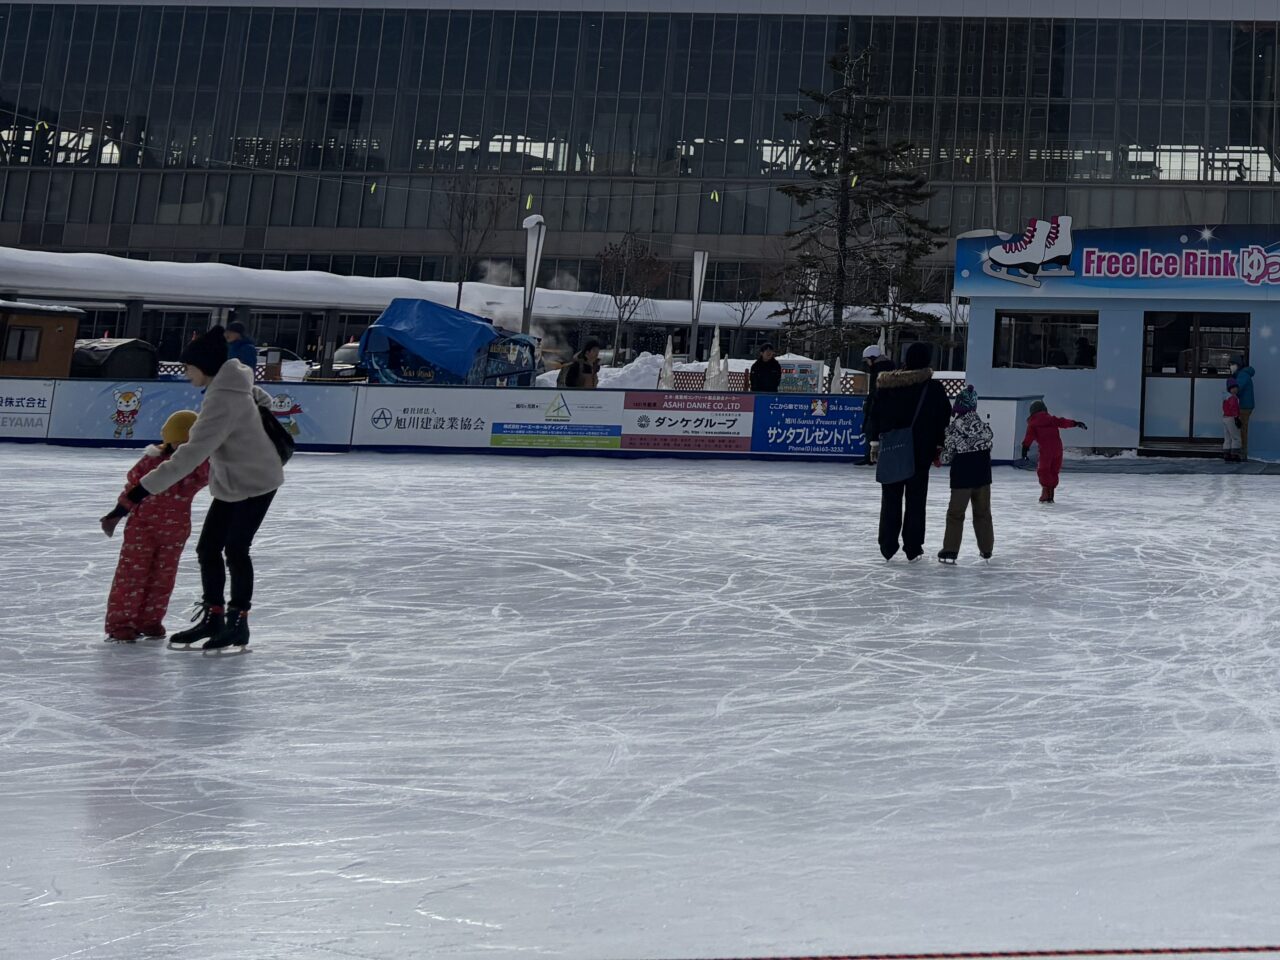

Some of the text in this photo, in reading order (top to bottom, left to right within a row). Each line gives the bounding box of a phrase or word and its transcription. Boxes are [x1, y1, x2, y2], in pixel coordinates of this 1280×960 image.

[1084, 248, 1136, 276] Free
[1140, 249, 1179, 277] Ice
[1183, 250, 1238, 278] Rink
[663, 401, 685, 409] ASAHI
[687, 402, 711, 410] DANKE
[0, 416, 43, 428] EYAMA
[394, 416, 485, 431] 旭川建設業協会
[655, 416, 738, 429] ダンケグループ
